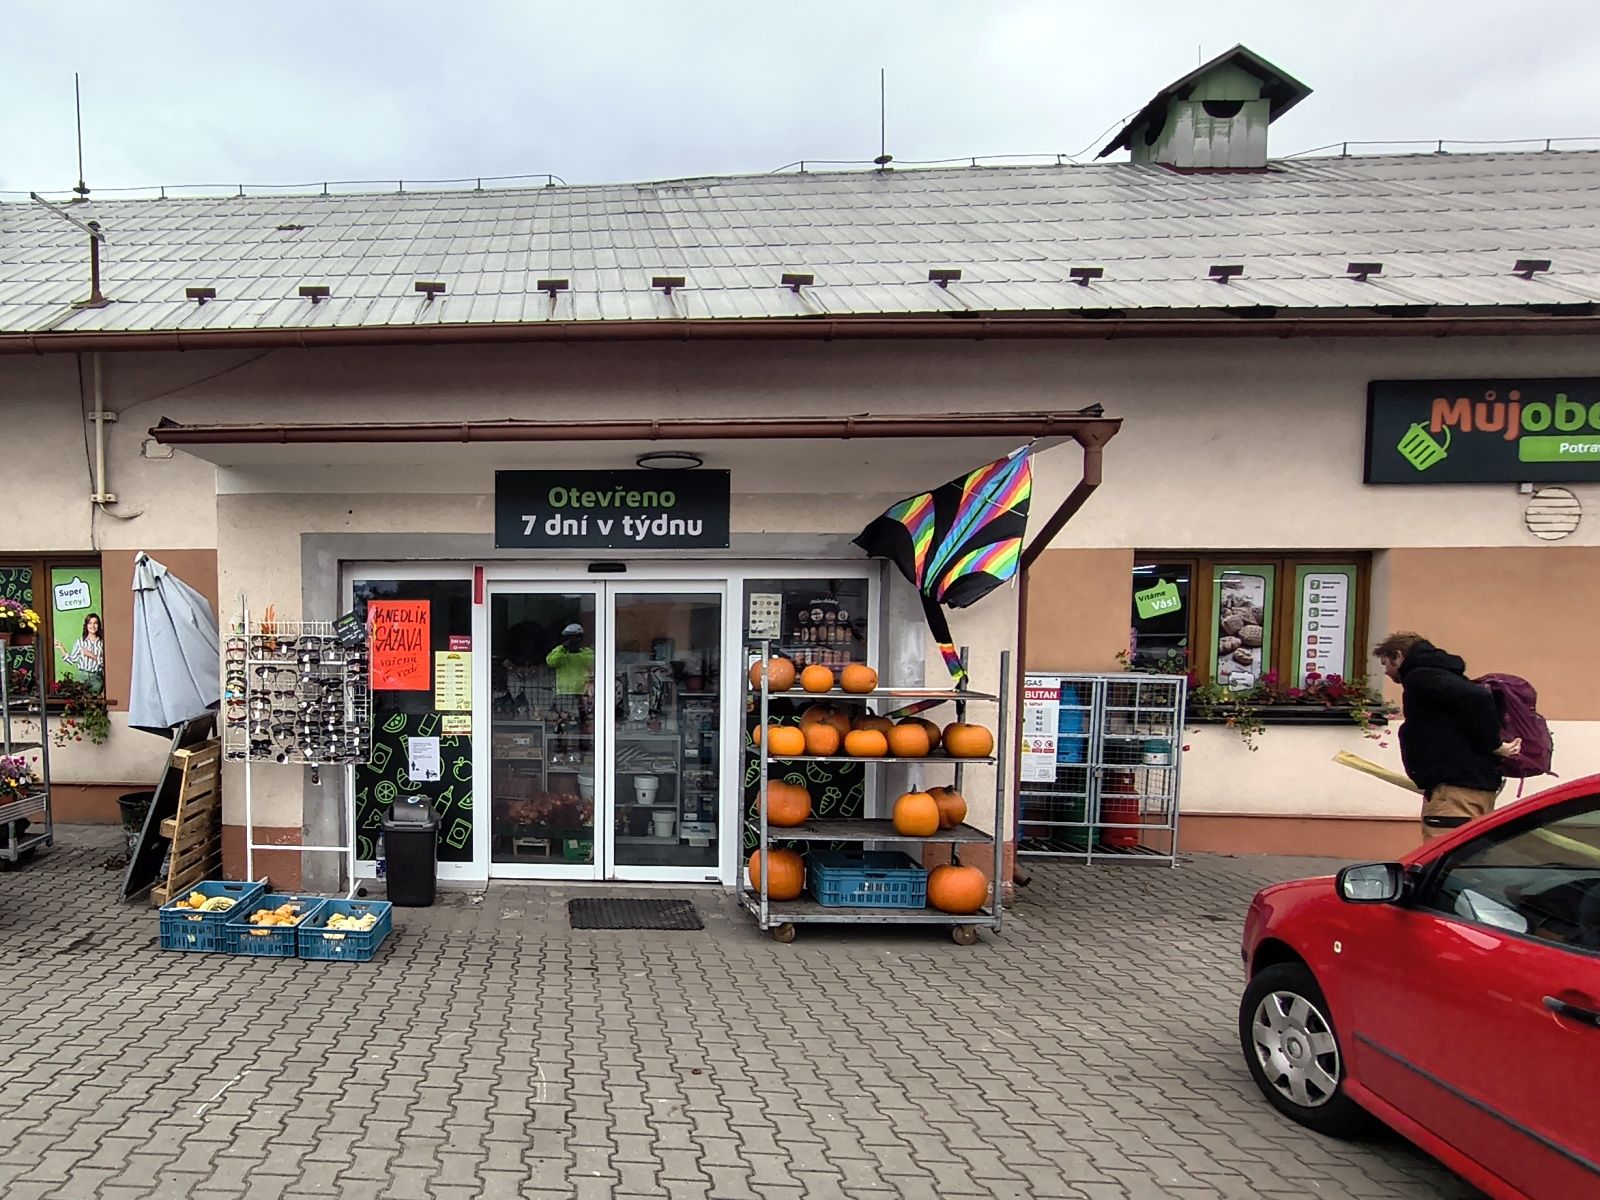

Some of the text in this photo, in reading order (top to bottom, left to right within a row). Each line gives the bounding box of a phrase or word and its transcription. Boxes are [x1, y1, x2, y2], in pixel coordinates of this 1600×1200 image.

[1559, 442, 1600, 454] Potra
[548, 486, 676, 508] Otevřeno
[521, 513, 703, 541] 7 dní v týdnu
[58, 588, 82, 597] Super
[1151, 596, 1177, 610] Vás!
[375, 606, 427, 625] KNEDLÍK
[1025, 690, 1057, 699] BUTAN
